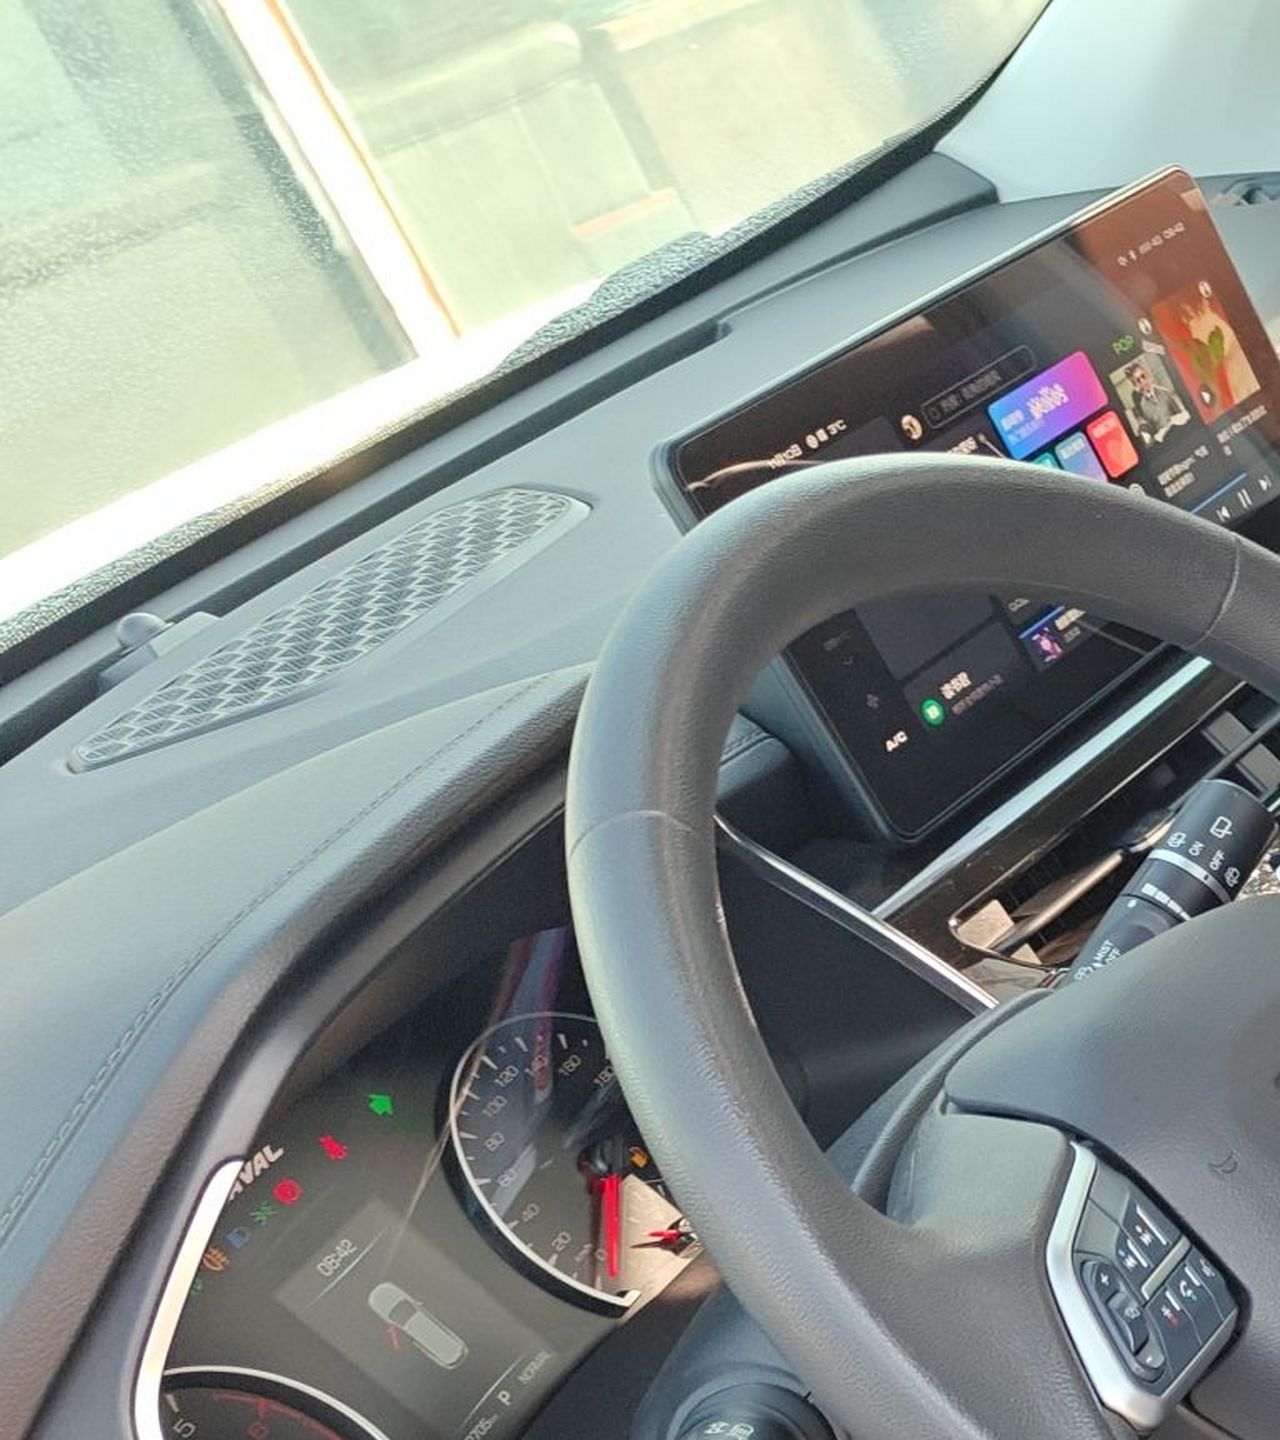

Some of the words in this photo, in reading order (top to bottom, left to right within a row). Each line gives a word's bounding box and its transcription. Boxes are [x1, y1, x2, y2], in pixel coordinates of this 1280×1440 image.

[886, 730, 908, 752] A/C
[1189, 841, 1205, 856] ON
[559, 1054, 581, 1077] 160
[494, 1065, 519, 1088] 120
[484, 1094, 508, 1119] 100
[484, 1131, 505, 1151] 80
[500, 1167, 519, 1188] 60
[522, 1202, 540, 1223] 40
[551, 1230, 571, 1251] 20
[317, 1239, 357, 1276] 08:42
[497, 1391, 511, 1406] P
[172, 1418, 196, 1439] 5
[248, 1421, 270, 1440] 6
